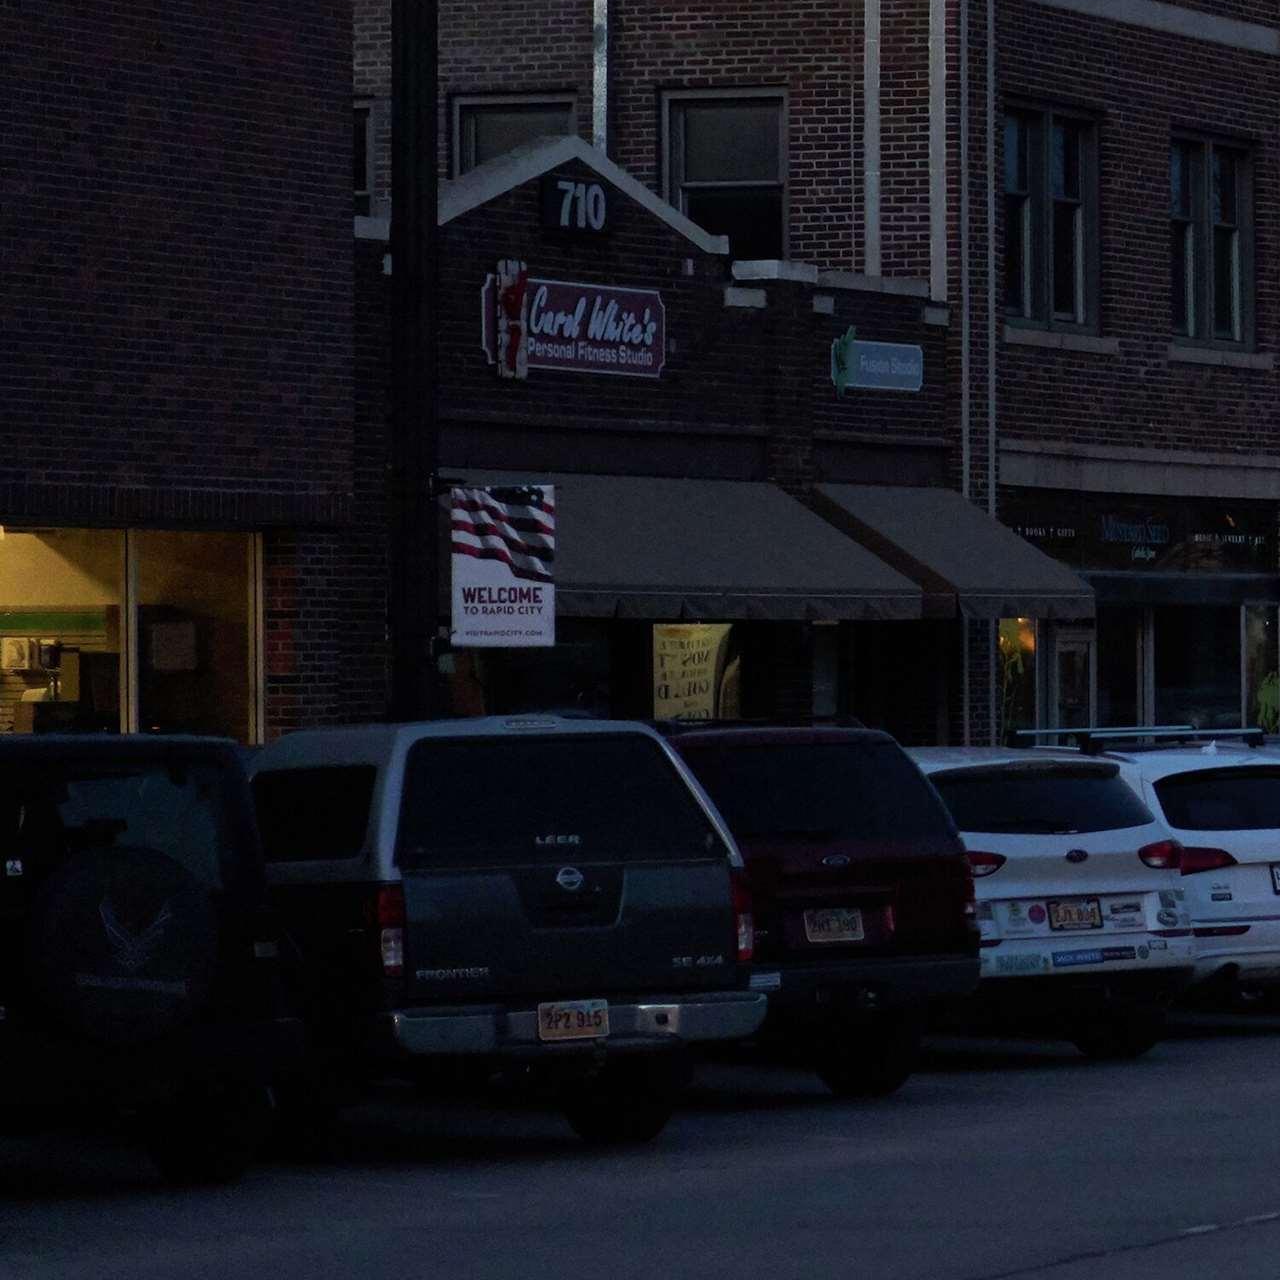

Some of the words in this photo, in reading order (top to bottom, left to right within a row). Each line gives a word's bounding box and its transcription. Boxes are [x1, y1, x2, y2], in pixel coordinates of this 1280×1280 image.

[557, 180, 607, 231] 710
[530, 285, 586, 339] Carol
[587, 295, 656, 347] White's
[528, 336, 575, 361] Personal
[578, 341, 617, 363] Fitness
[619, 345, 653, 366] Studio
[463, 587, 543, 604] WELCOME
[464, 606, 479, 615] TO
[482, 606, 515, 615] RAPID
[519, 606, 543, 615] CITY
[535, 834, 581, 846] LEER
[415, 967, 490, 983] FRONTIER
